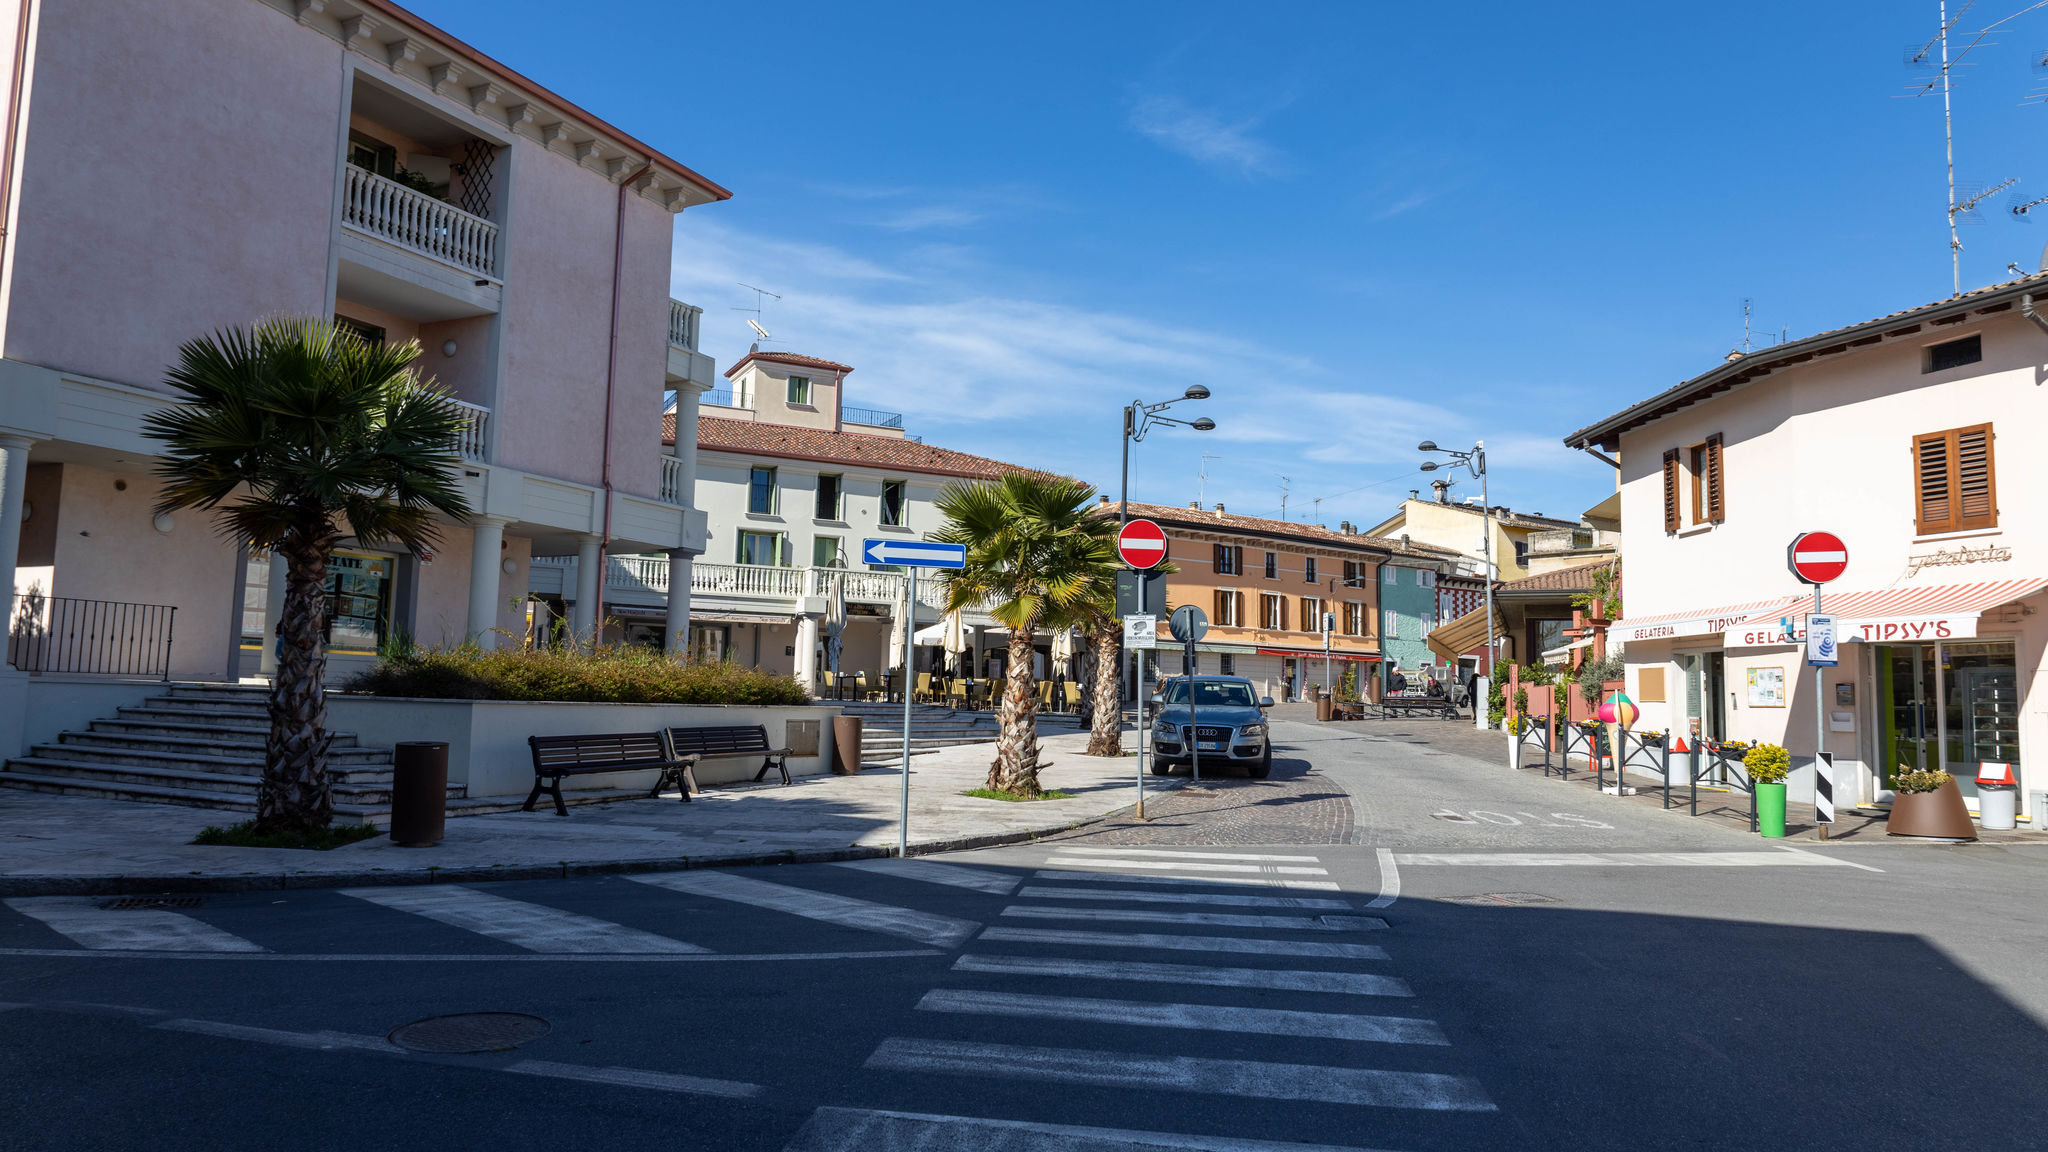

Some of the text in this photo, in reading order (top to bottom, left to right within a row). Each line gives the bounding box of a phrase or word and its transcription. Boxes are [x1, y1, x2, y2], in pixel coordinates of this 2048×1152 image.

[1634, 626, 1675, 639] GELATERIA
[1744, 629, 1806, 645] GELAE
[1860, 620, 1951, 641] TIPSY'S
[1432, 808, 1615, 829] STOP
